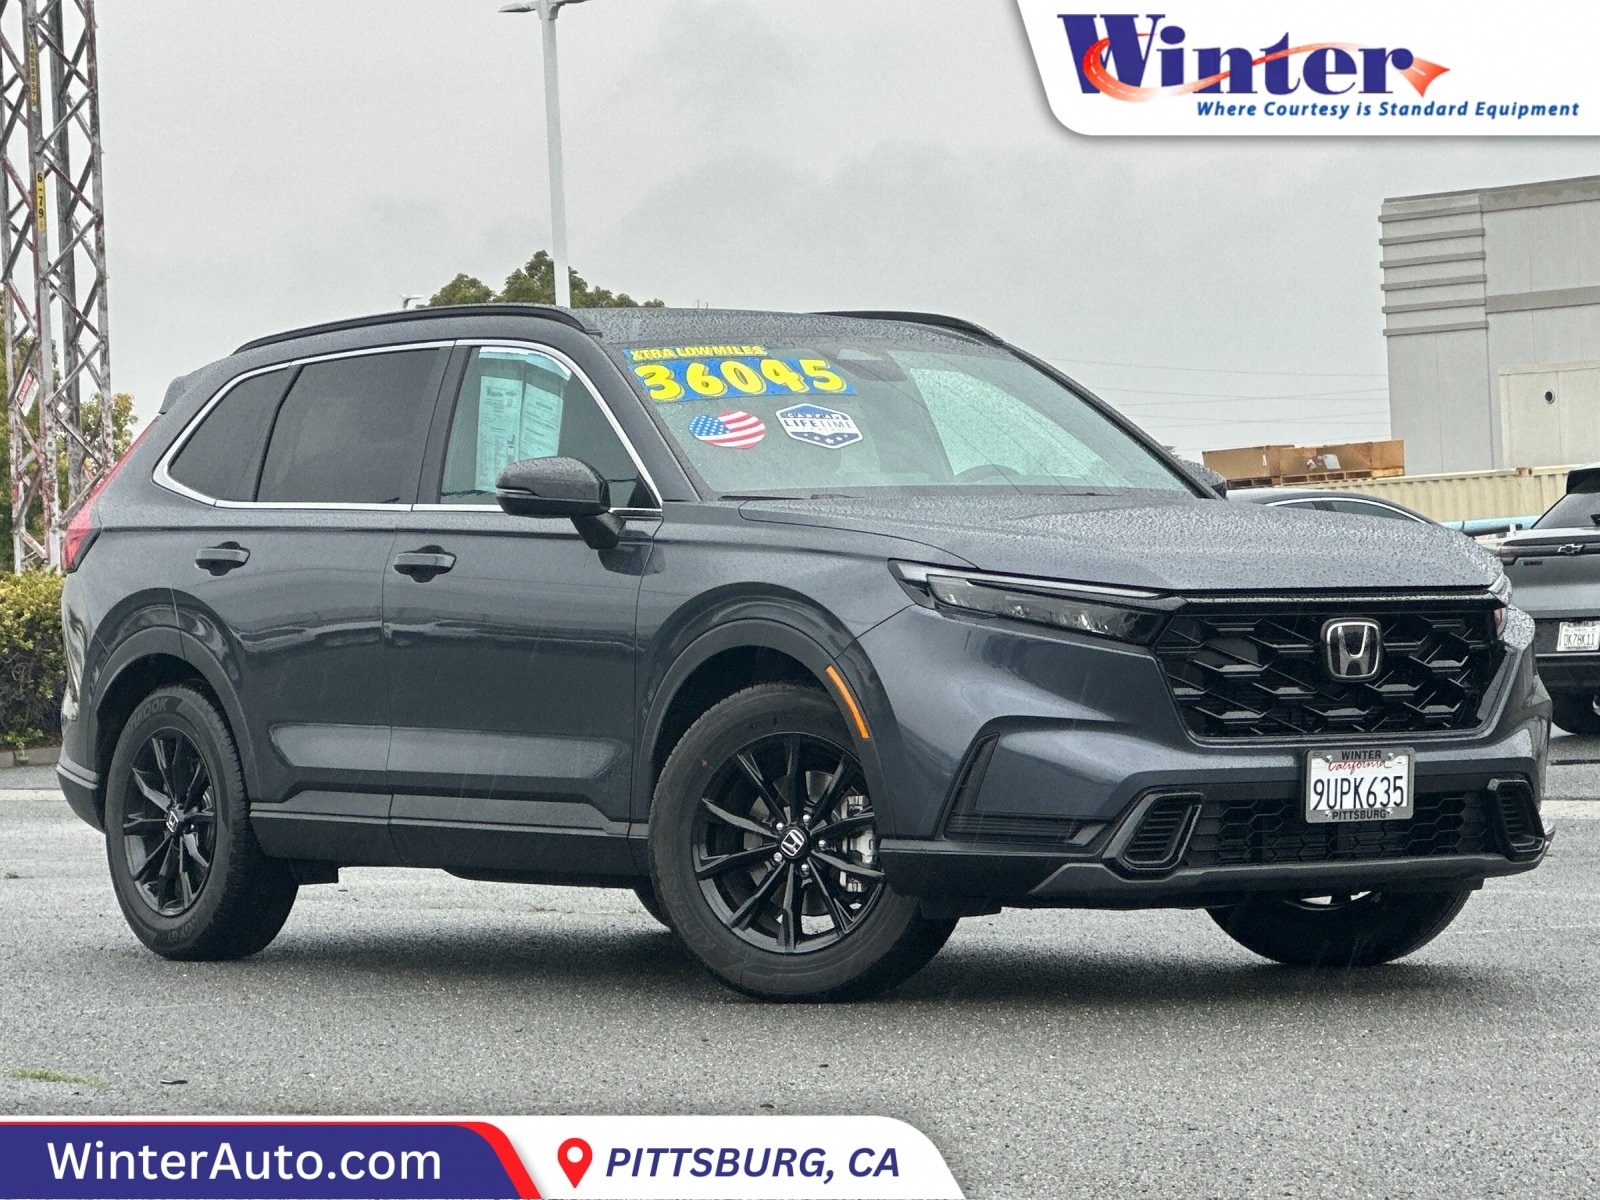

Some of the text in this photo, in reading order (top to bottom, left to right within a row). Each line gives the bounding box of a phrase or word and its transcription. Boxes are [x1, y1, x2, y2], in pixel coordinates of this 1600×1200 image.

[633, 359, 848, 401] 36045
[783, 419, 855, 429] LIFETIME
[1341, 749, 1382, 761] WINTER
[1313, 776, 1404, 811] 9UPK635
[1332, 809, 1386, 820] PITTSBURG
